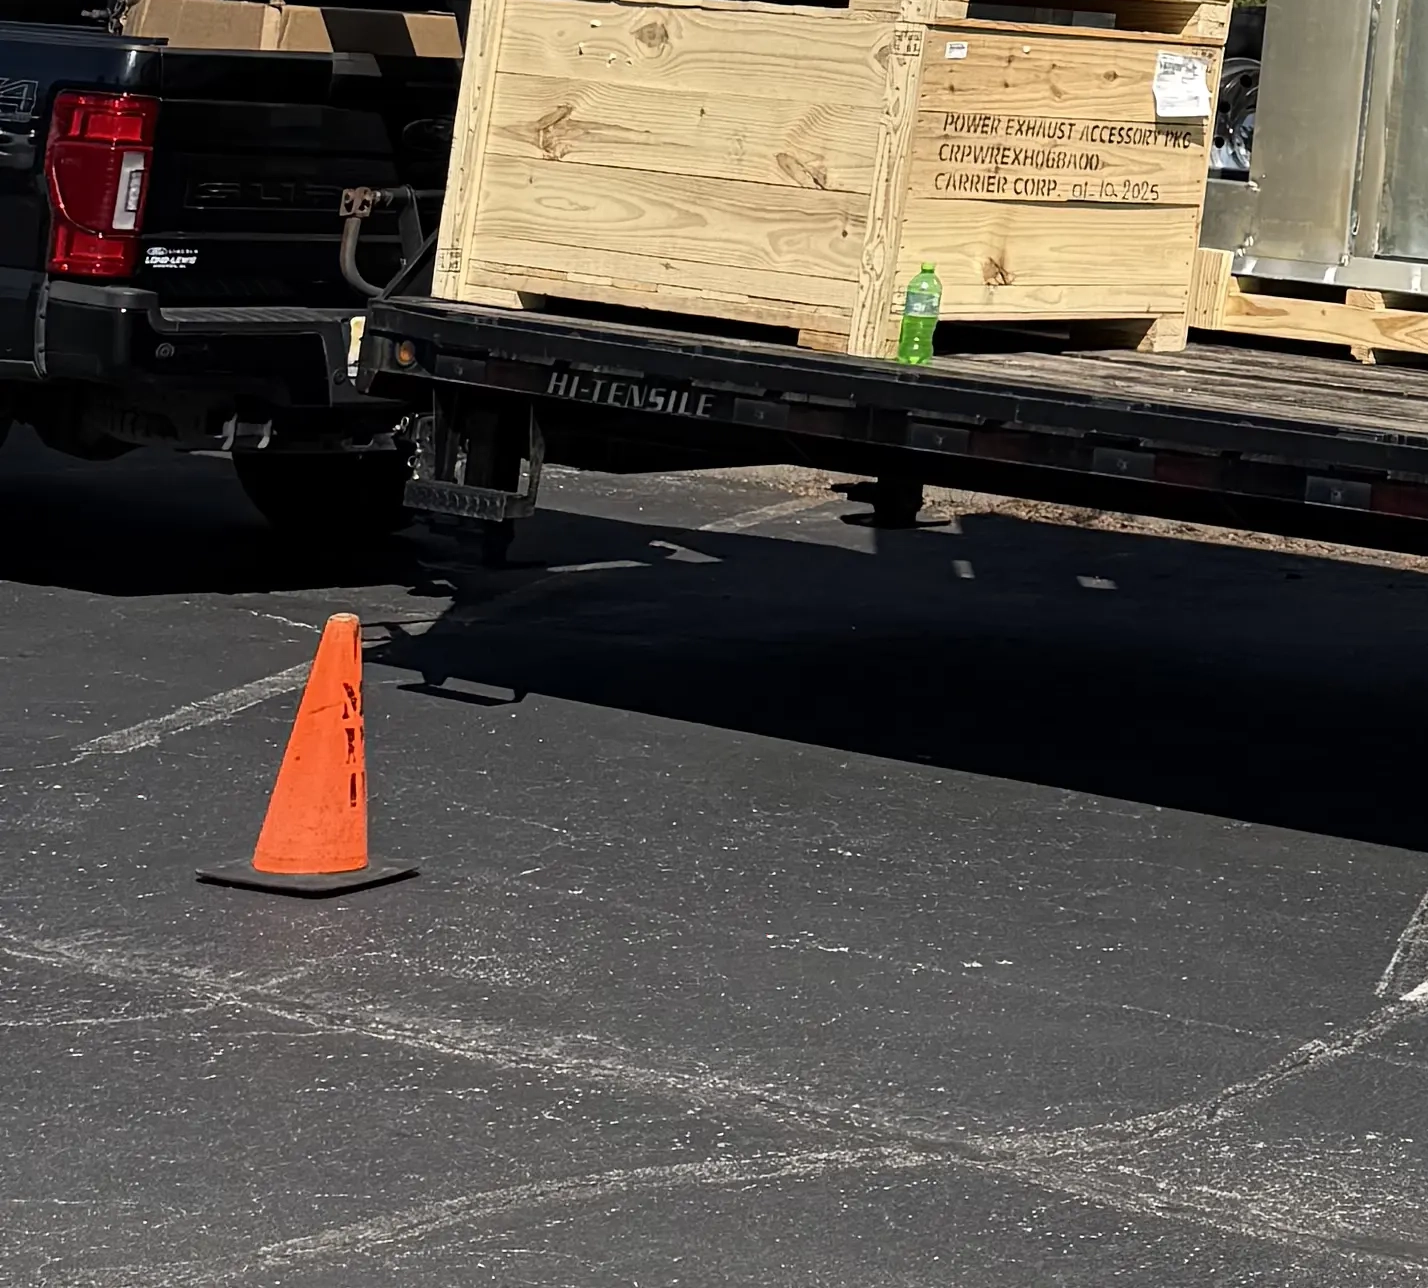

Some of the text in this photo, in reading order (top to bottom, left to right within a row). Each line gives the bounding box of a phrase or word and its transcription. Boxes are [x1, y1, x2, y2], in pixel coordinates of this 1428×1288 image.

[943, 112, 1192, 149] POWER EXHAUST ACCESSORY PKG
[934, 172, 1061, 198] CARRIER CORP.
[547, 372, 716, 418] HI-TENSILE
